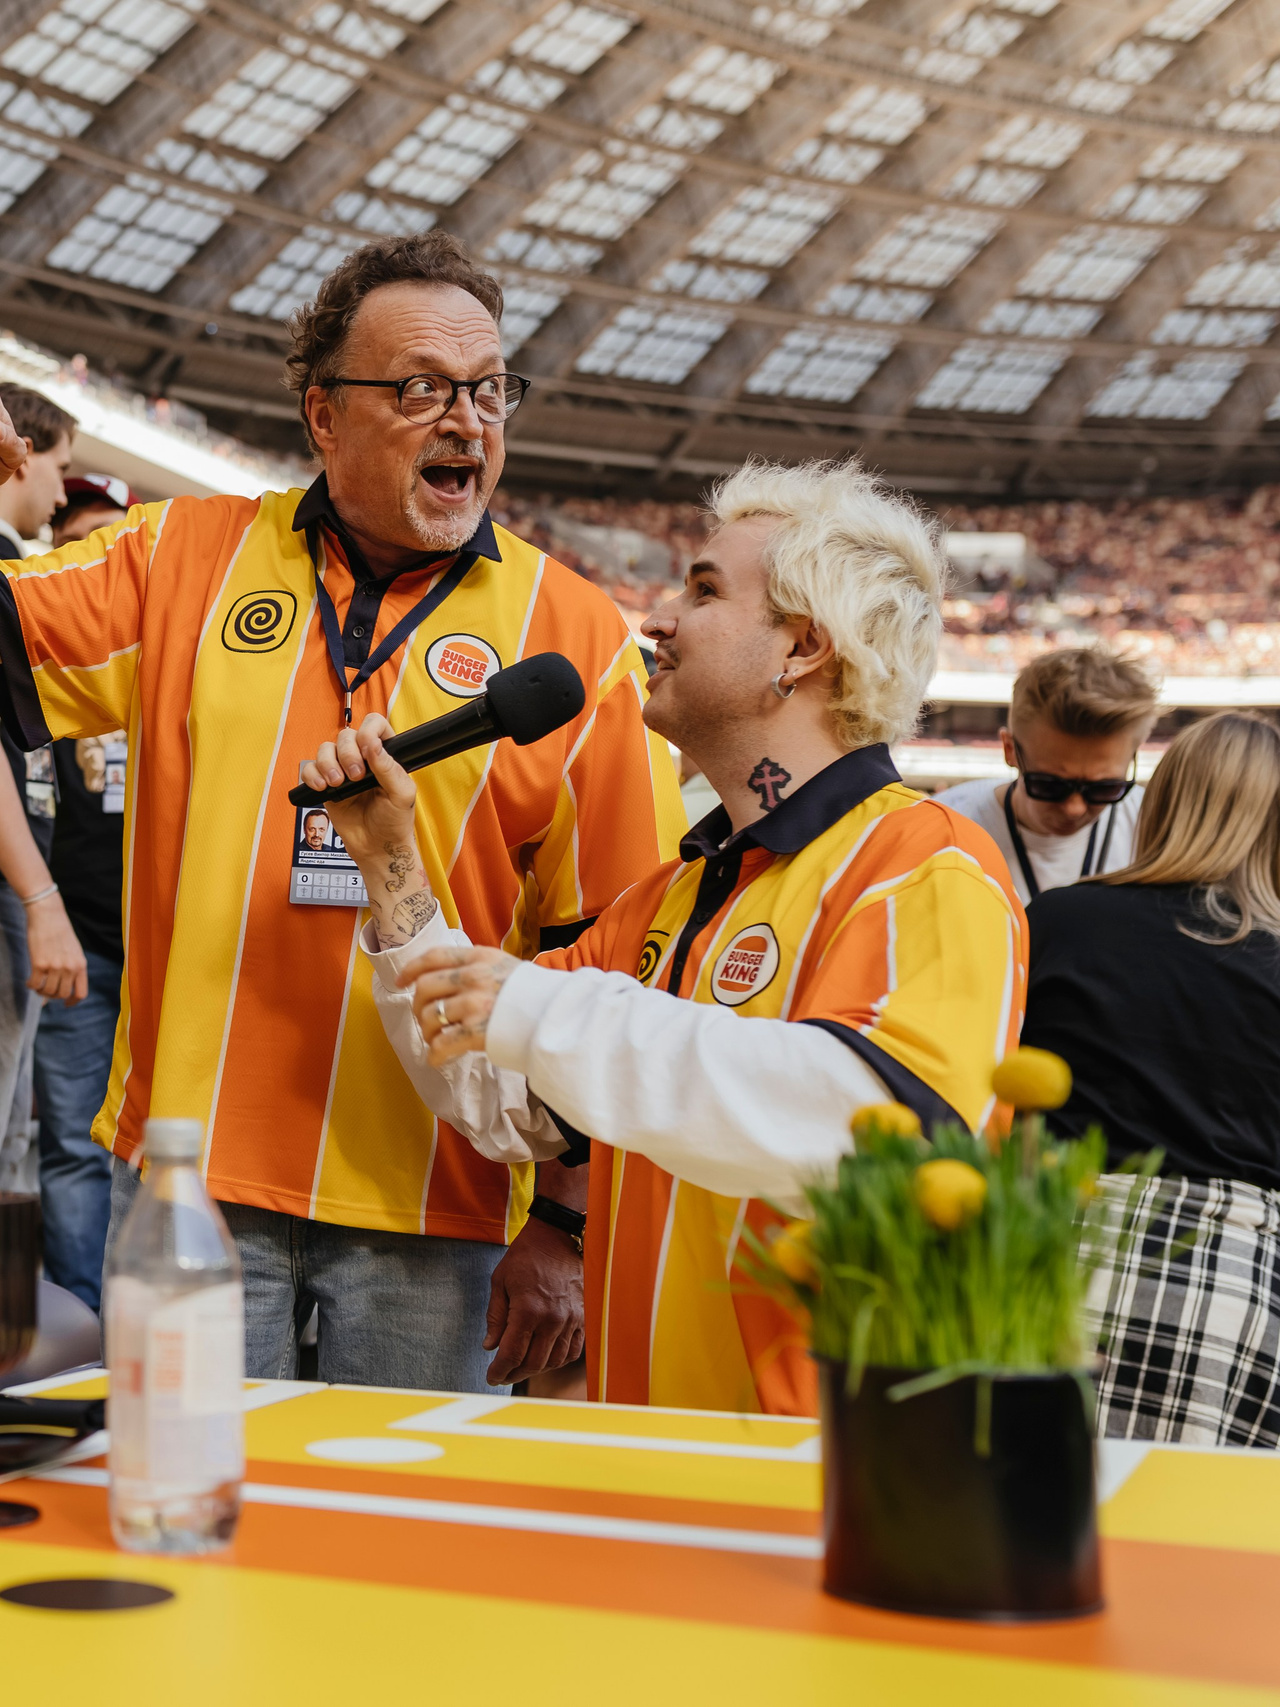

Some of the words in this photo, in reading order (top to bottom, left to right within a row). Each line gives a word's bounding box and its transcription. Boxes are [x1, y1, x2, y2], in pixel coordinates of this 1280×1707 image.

[438, 657, 484, 683] KING
[442, 649, 487, 672] BURGER
[301, 874, 308, 883] 0
[351, 877, 358, 886] 3
[720, 962, 759, 983] KING
